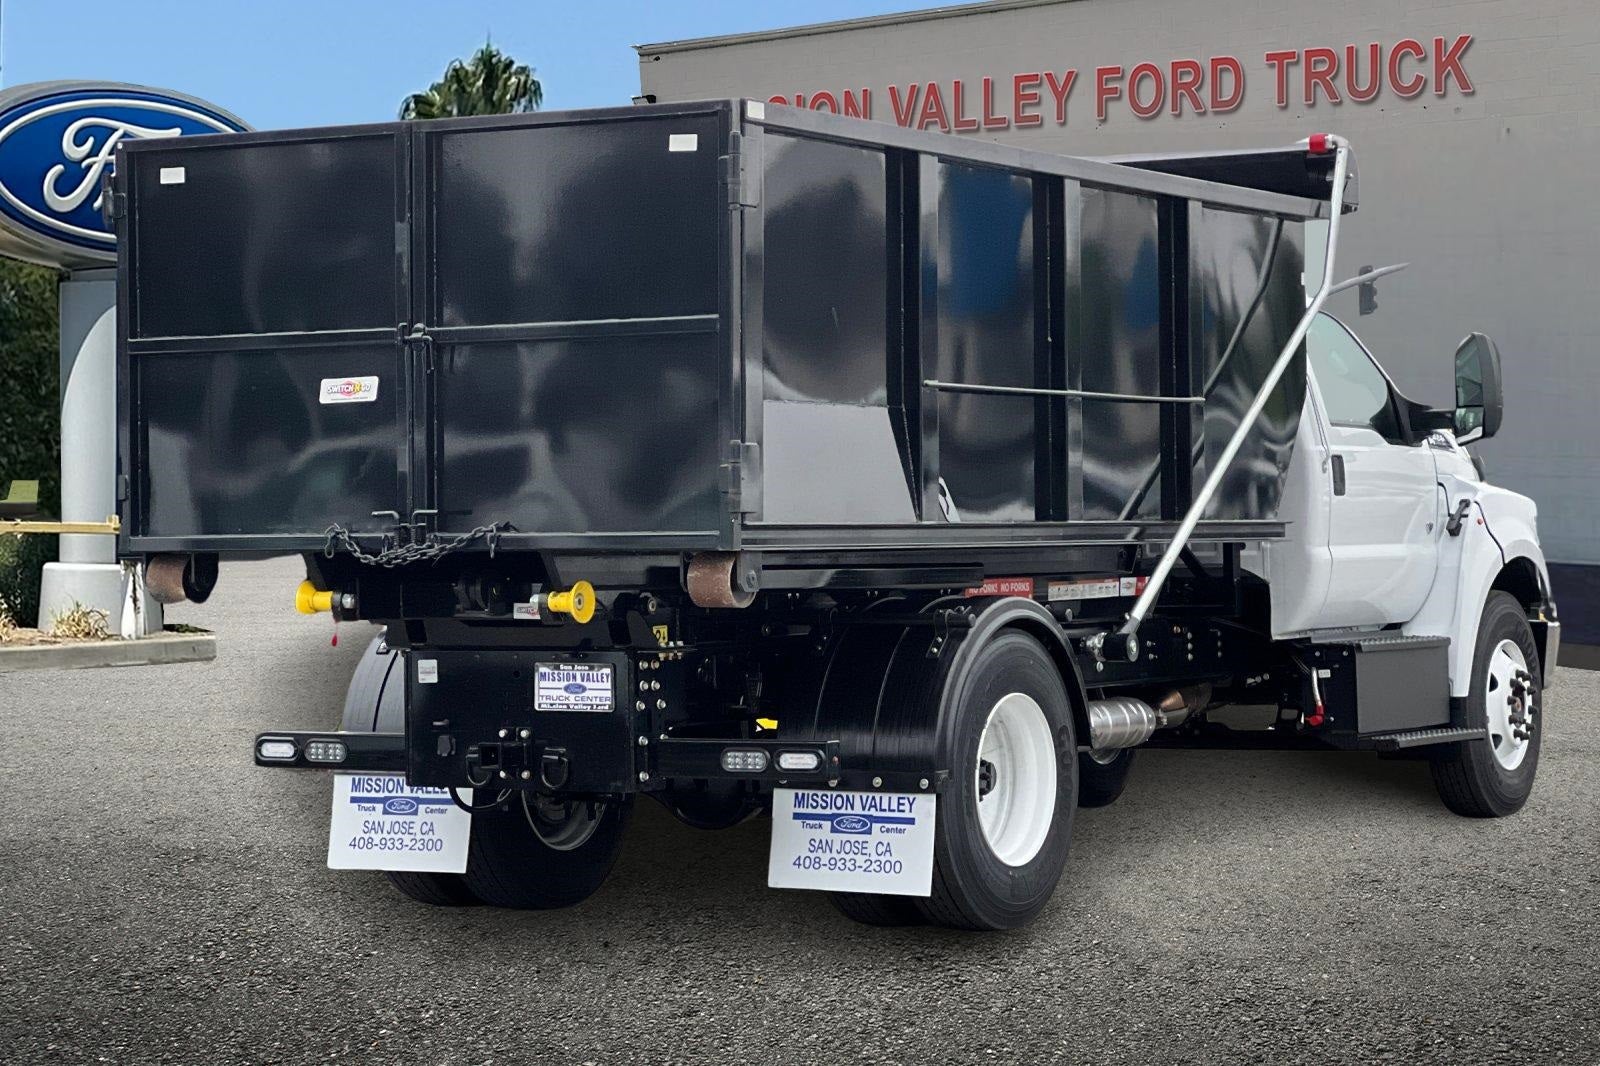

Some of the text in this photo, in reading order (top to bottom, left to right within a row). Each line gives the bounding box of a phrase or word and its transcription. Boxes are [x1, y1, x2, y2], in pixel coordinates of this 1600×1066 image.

[888, 69, 1077, 131] VALLEY
[1095, 55, 1244, 119] FORD
[1265, 34, 1473, 107] TRUCK
[1000, 584, 1010, 592] NO
[1010, 582, 1030, 592] FORKS
[540, 671, 610, 683] MISSION VALLEY
[351, 777, 405, 794] MISSION
[357, 804, 376, 812] Truck
[794, 792, 917, 813] MISSION VALLEY
[424, 806, 448, 815] Center
[362, 820, 435, 836] SAN JOSE, CA
[801, 821, 824, 830] Truck
[840, 818, 863, 829] Ford
[879, 825, 907, 835] Center
[348, 836, 444, 852] 408-933-2300
[808, 838, 893, 858] SAN JOSE, CA
[792, 855, 903, 875] 408-933-2300
